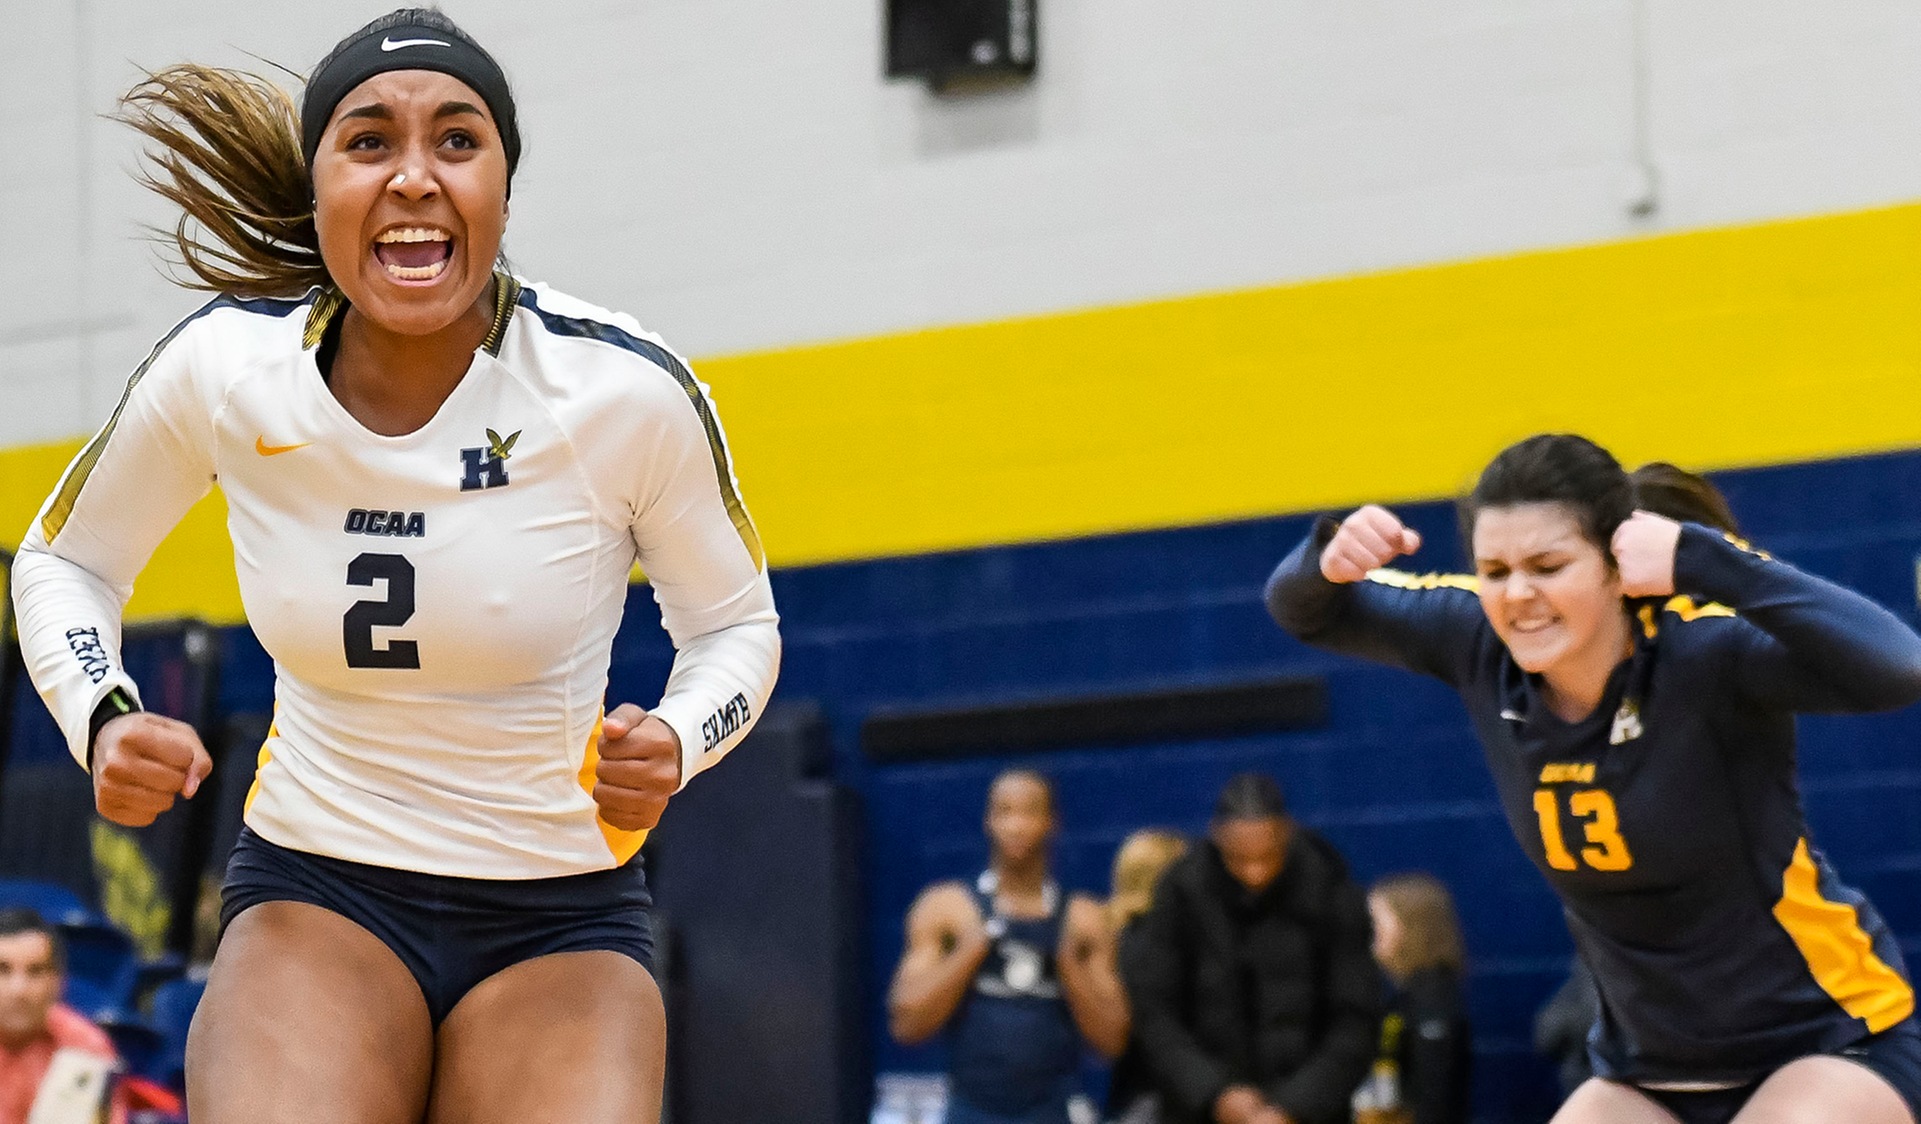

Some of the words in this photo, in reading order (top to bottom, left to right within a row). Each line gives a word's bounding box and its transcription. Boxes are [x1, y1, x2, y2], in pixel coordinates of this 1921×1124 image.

[344, 508, 426, 537] OCAA
[343, 552, 421, 668] 2
[701, 691, 751, 754] HAWKS
[1533, 788, 1634, 871] 13
